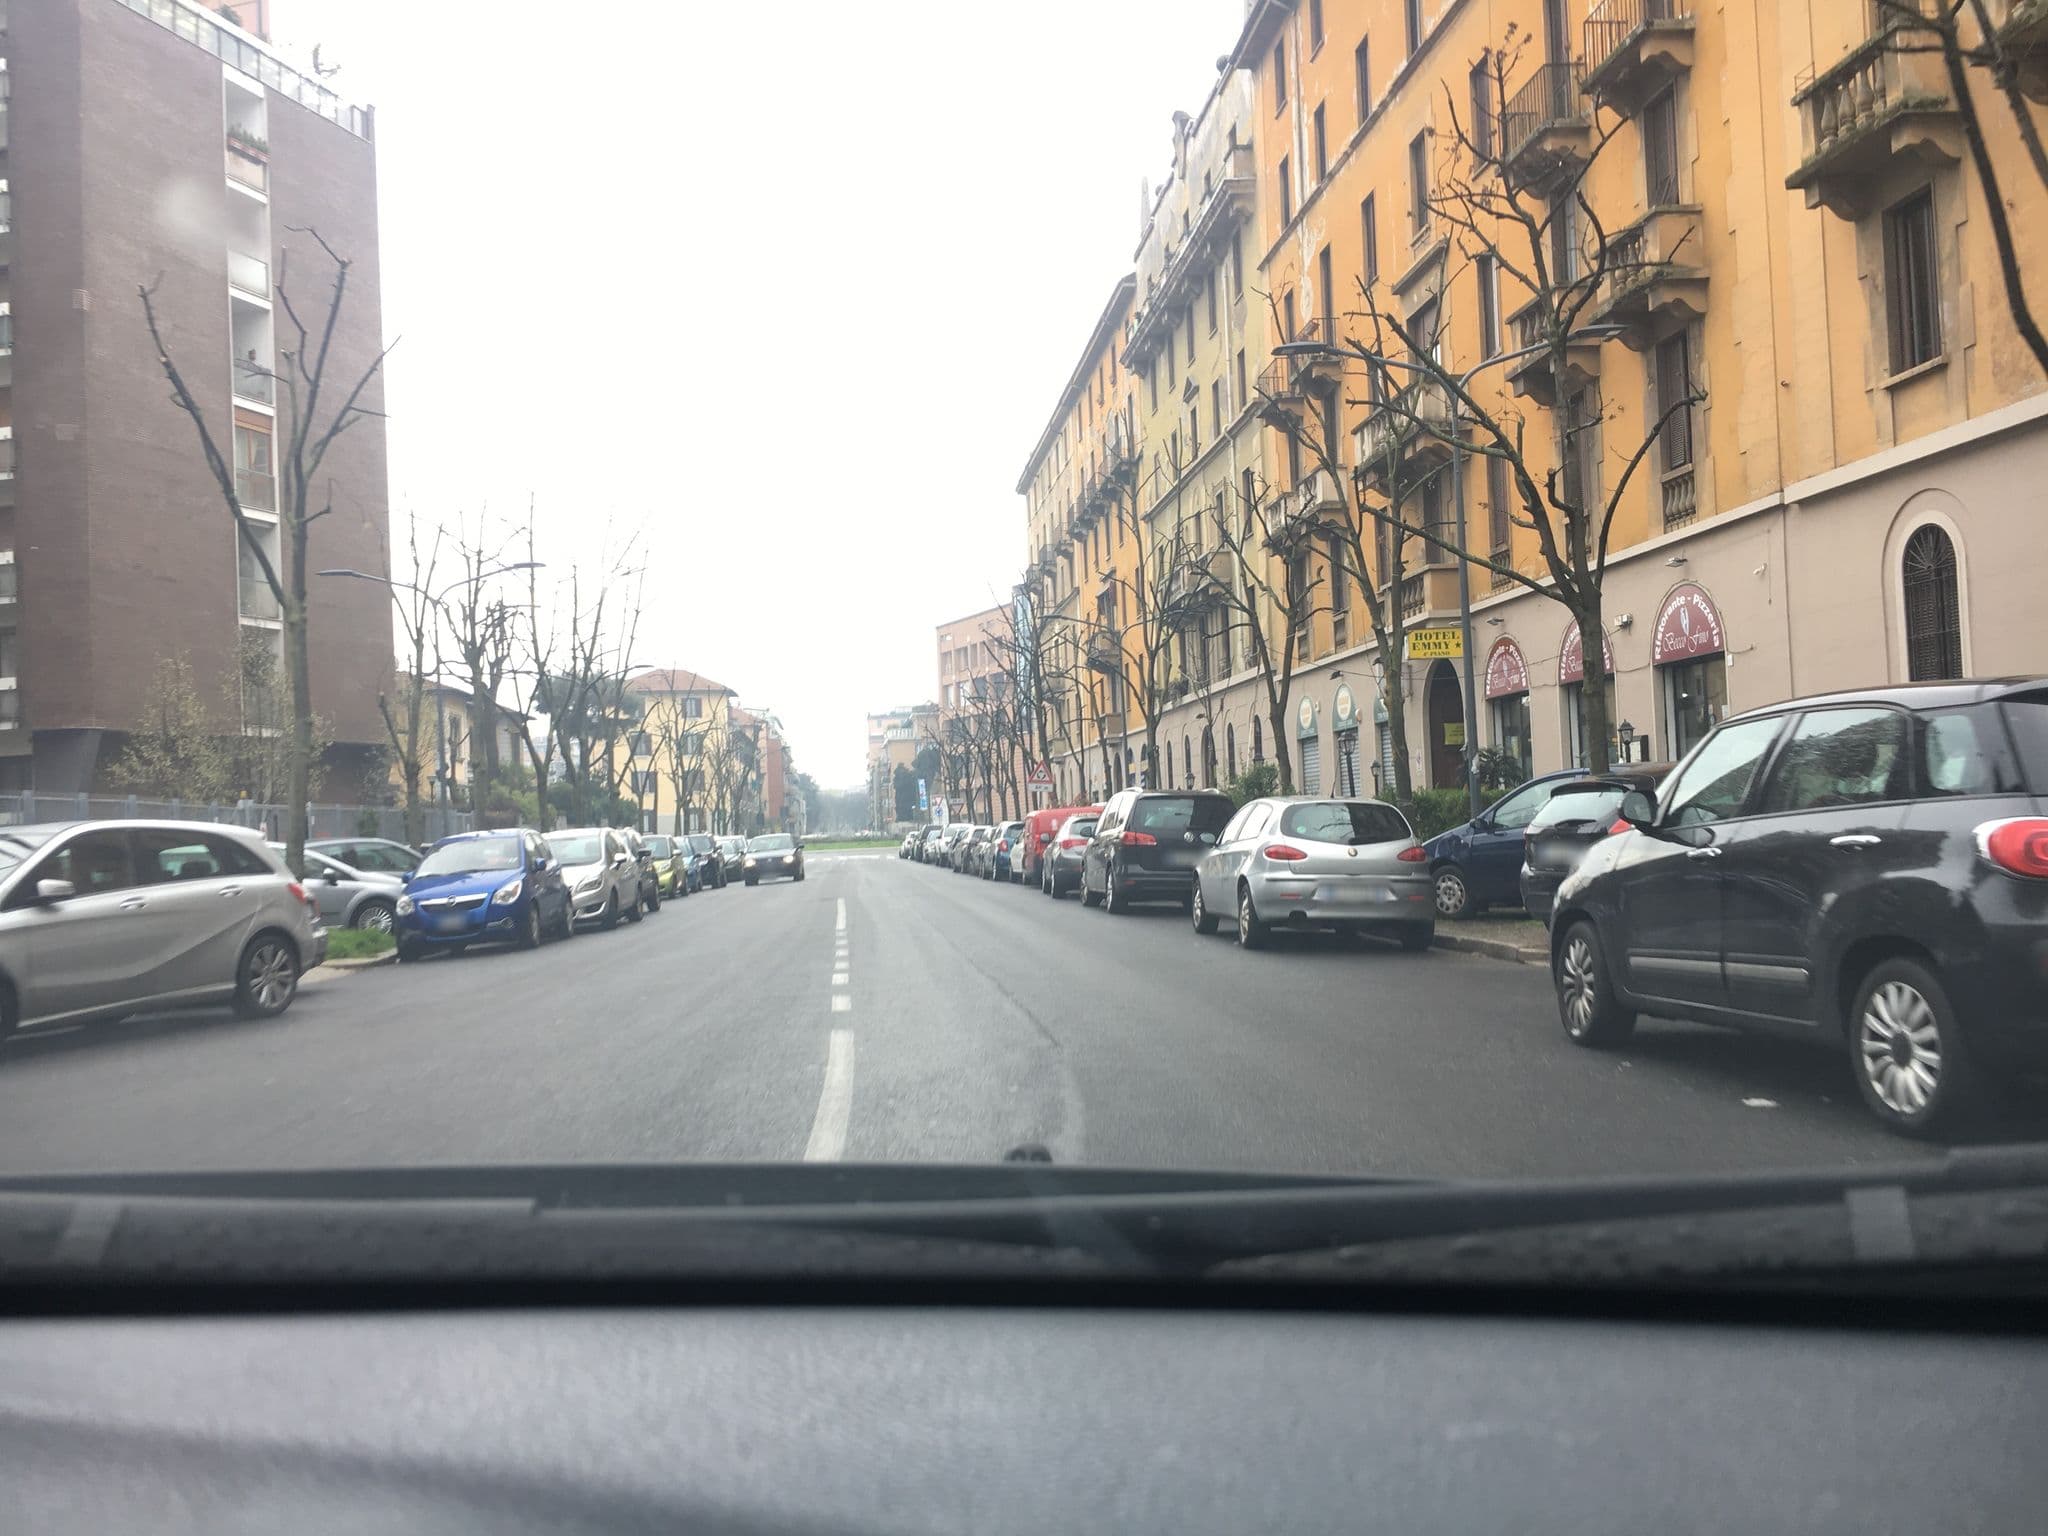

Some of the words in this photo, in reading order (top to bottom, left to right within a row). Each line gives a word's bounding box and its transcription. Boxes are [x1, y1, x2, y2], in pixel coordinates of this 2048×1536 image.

[1654, 595, 1686, 660] Ristorante
[1693, 593, 1719, 648] Pizzeria
[1414, 631, 1460, 641] HOTEL
[1412, 641, 1450, 651] EMMY
